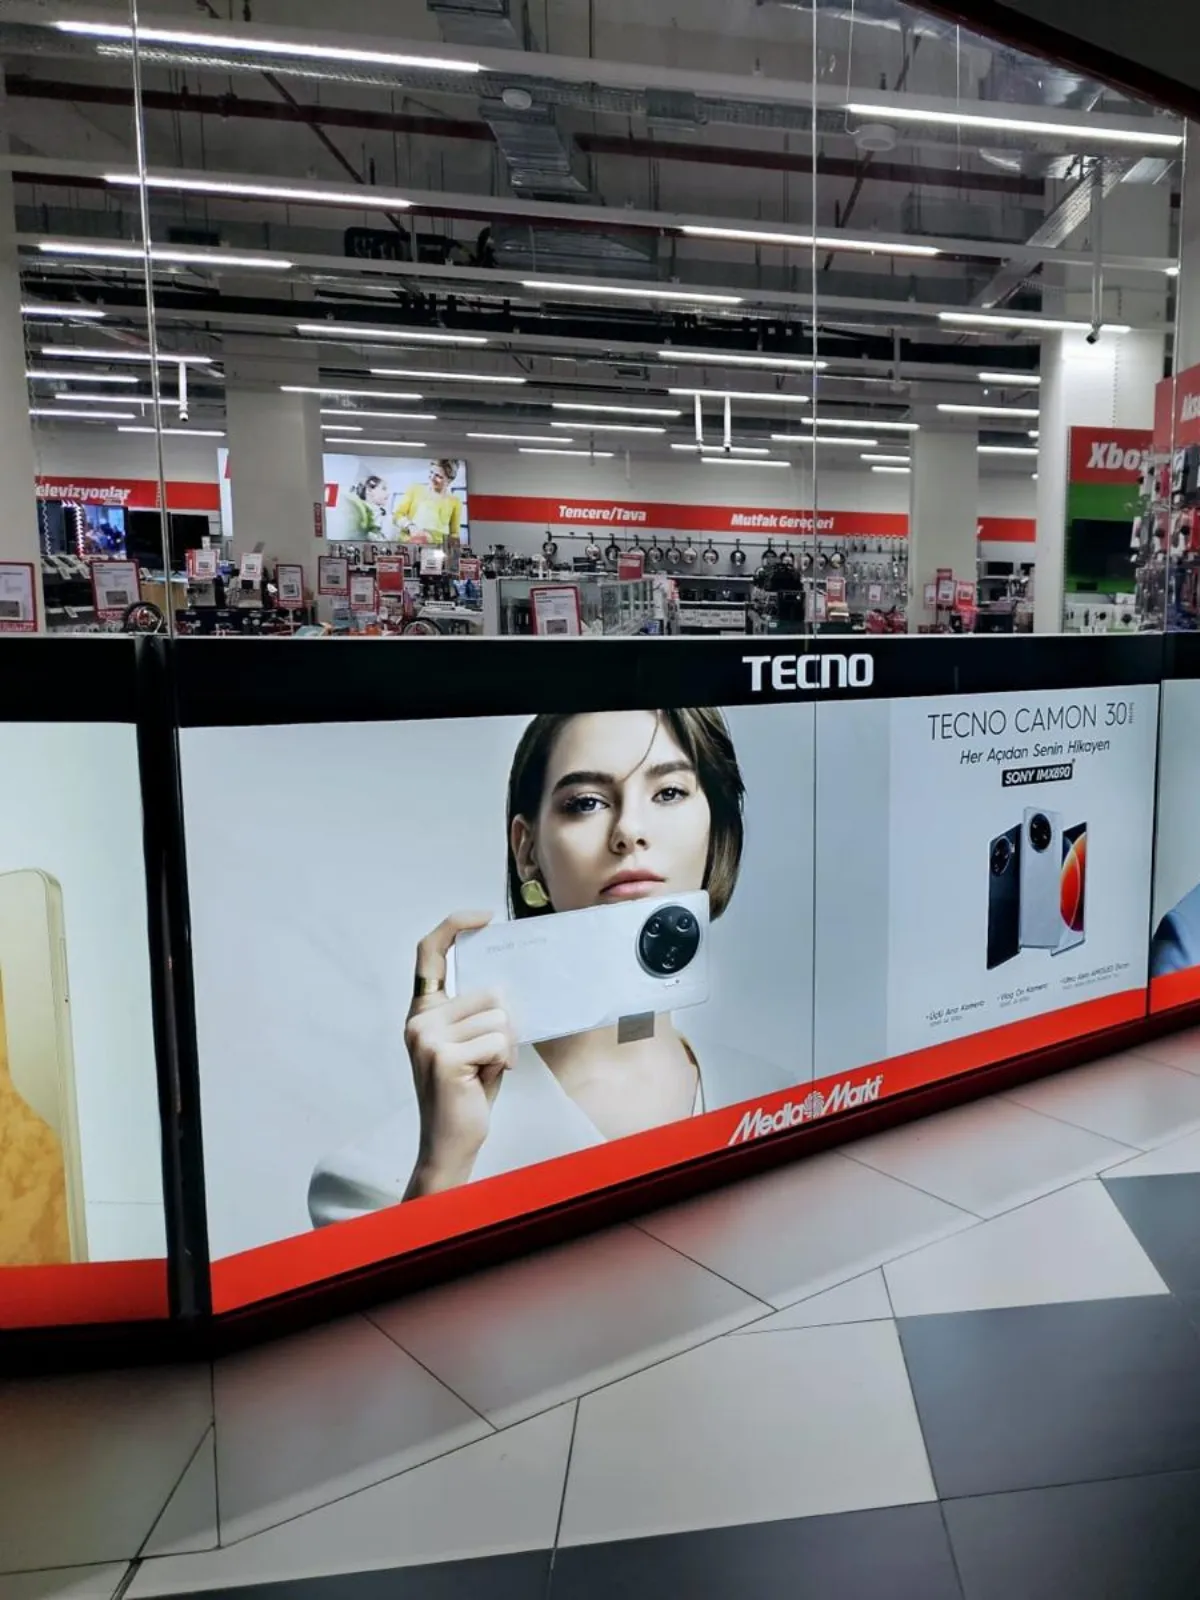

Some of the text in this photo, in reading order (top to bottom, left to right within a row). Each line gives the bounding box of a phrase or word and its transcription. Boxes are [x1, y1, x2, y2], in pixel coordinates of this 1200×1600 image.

[34, 483, 131, 501] elevizyonlar
[558, 504, 647, 522] Tencere/Tava
[731, 513, 777, 529] Mutfak
[742, 653, 874, 691] TECNO
[927, 709, 1007, 740] TECNO
[1014, 704, 1097, 734] CAMON
[1104, 702, 1128, 726] 30
[960, 739, 1111, 766] Her Açıdan Senin Hikayen
[1004, 769, 1035, 785] SONY
[727, 1074, 884, 1146] Media Markt
